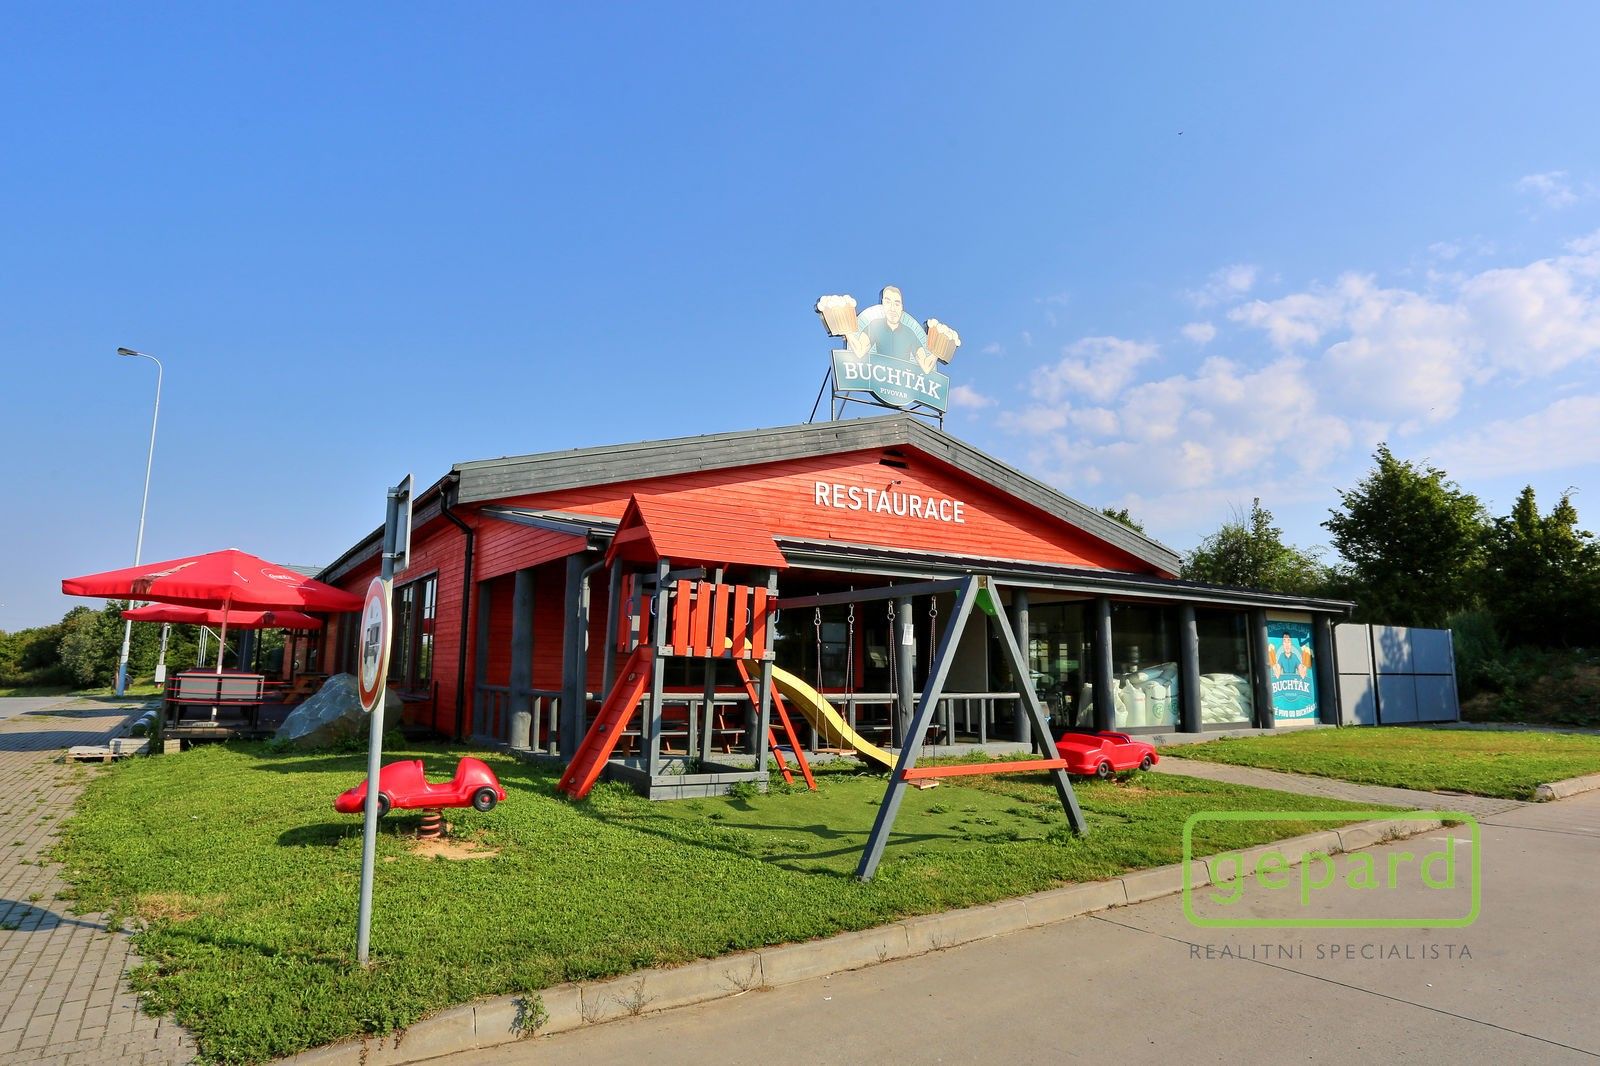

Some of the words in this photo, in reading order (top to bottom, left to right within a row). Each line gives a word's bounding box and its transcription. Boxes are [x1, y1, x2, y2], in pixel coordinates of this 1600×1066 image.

[843, 362, 942, 400] BUCHŤÁK
[880, 387, 908, 399] PIVOVAR
[815, 481, 965, 523] RESTAURACE
